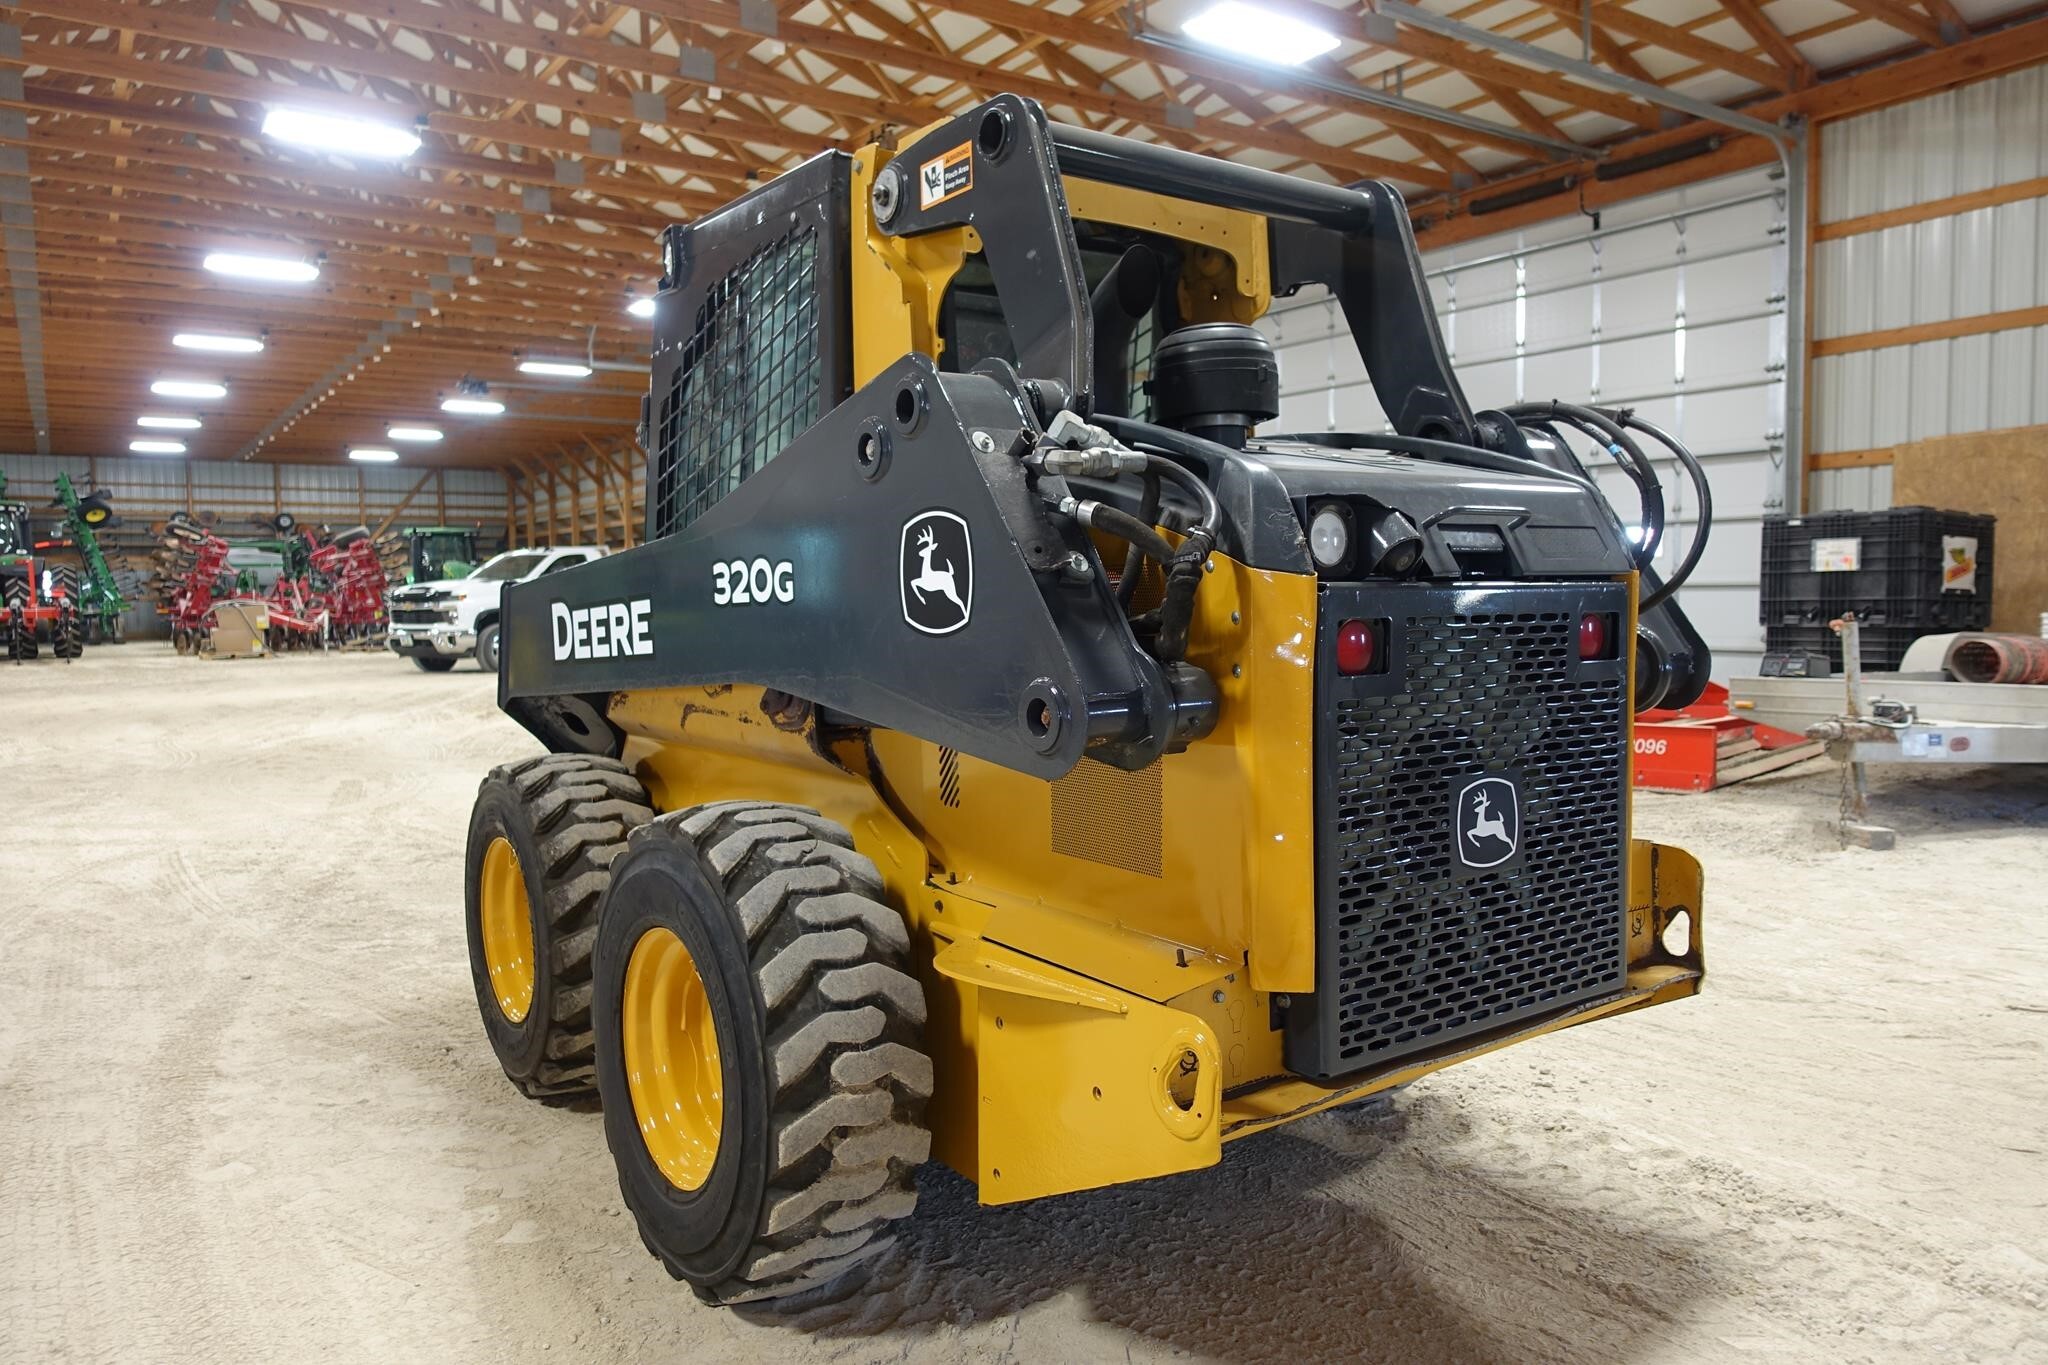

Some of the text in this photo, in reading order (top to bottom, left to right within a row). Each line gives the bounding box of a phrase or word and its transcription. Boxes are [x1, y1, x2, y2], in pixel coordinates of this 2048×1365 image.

[713, 558, 794, 605] 320G
[551, 599, 654, 661] DEERE
[1633, 738, 1668, 755] 096
